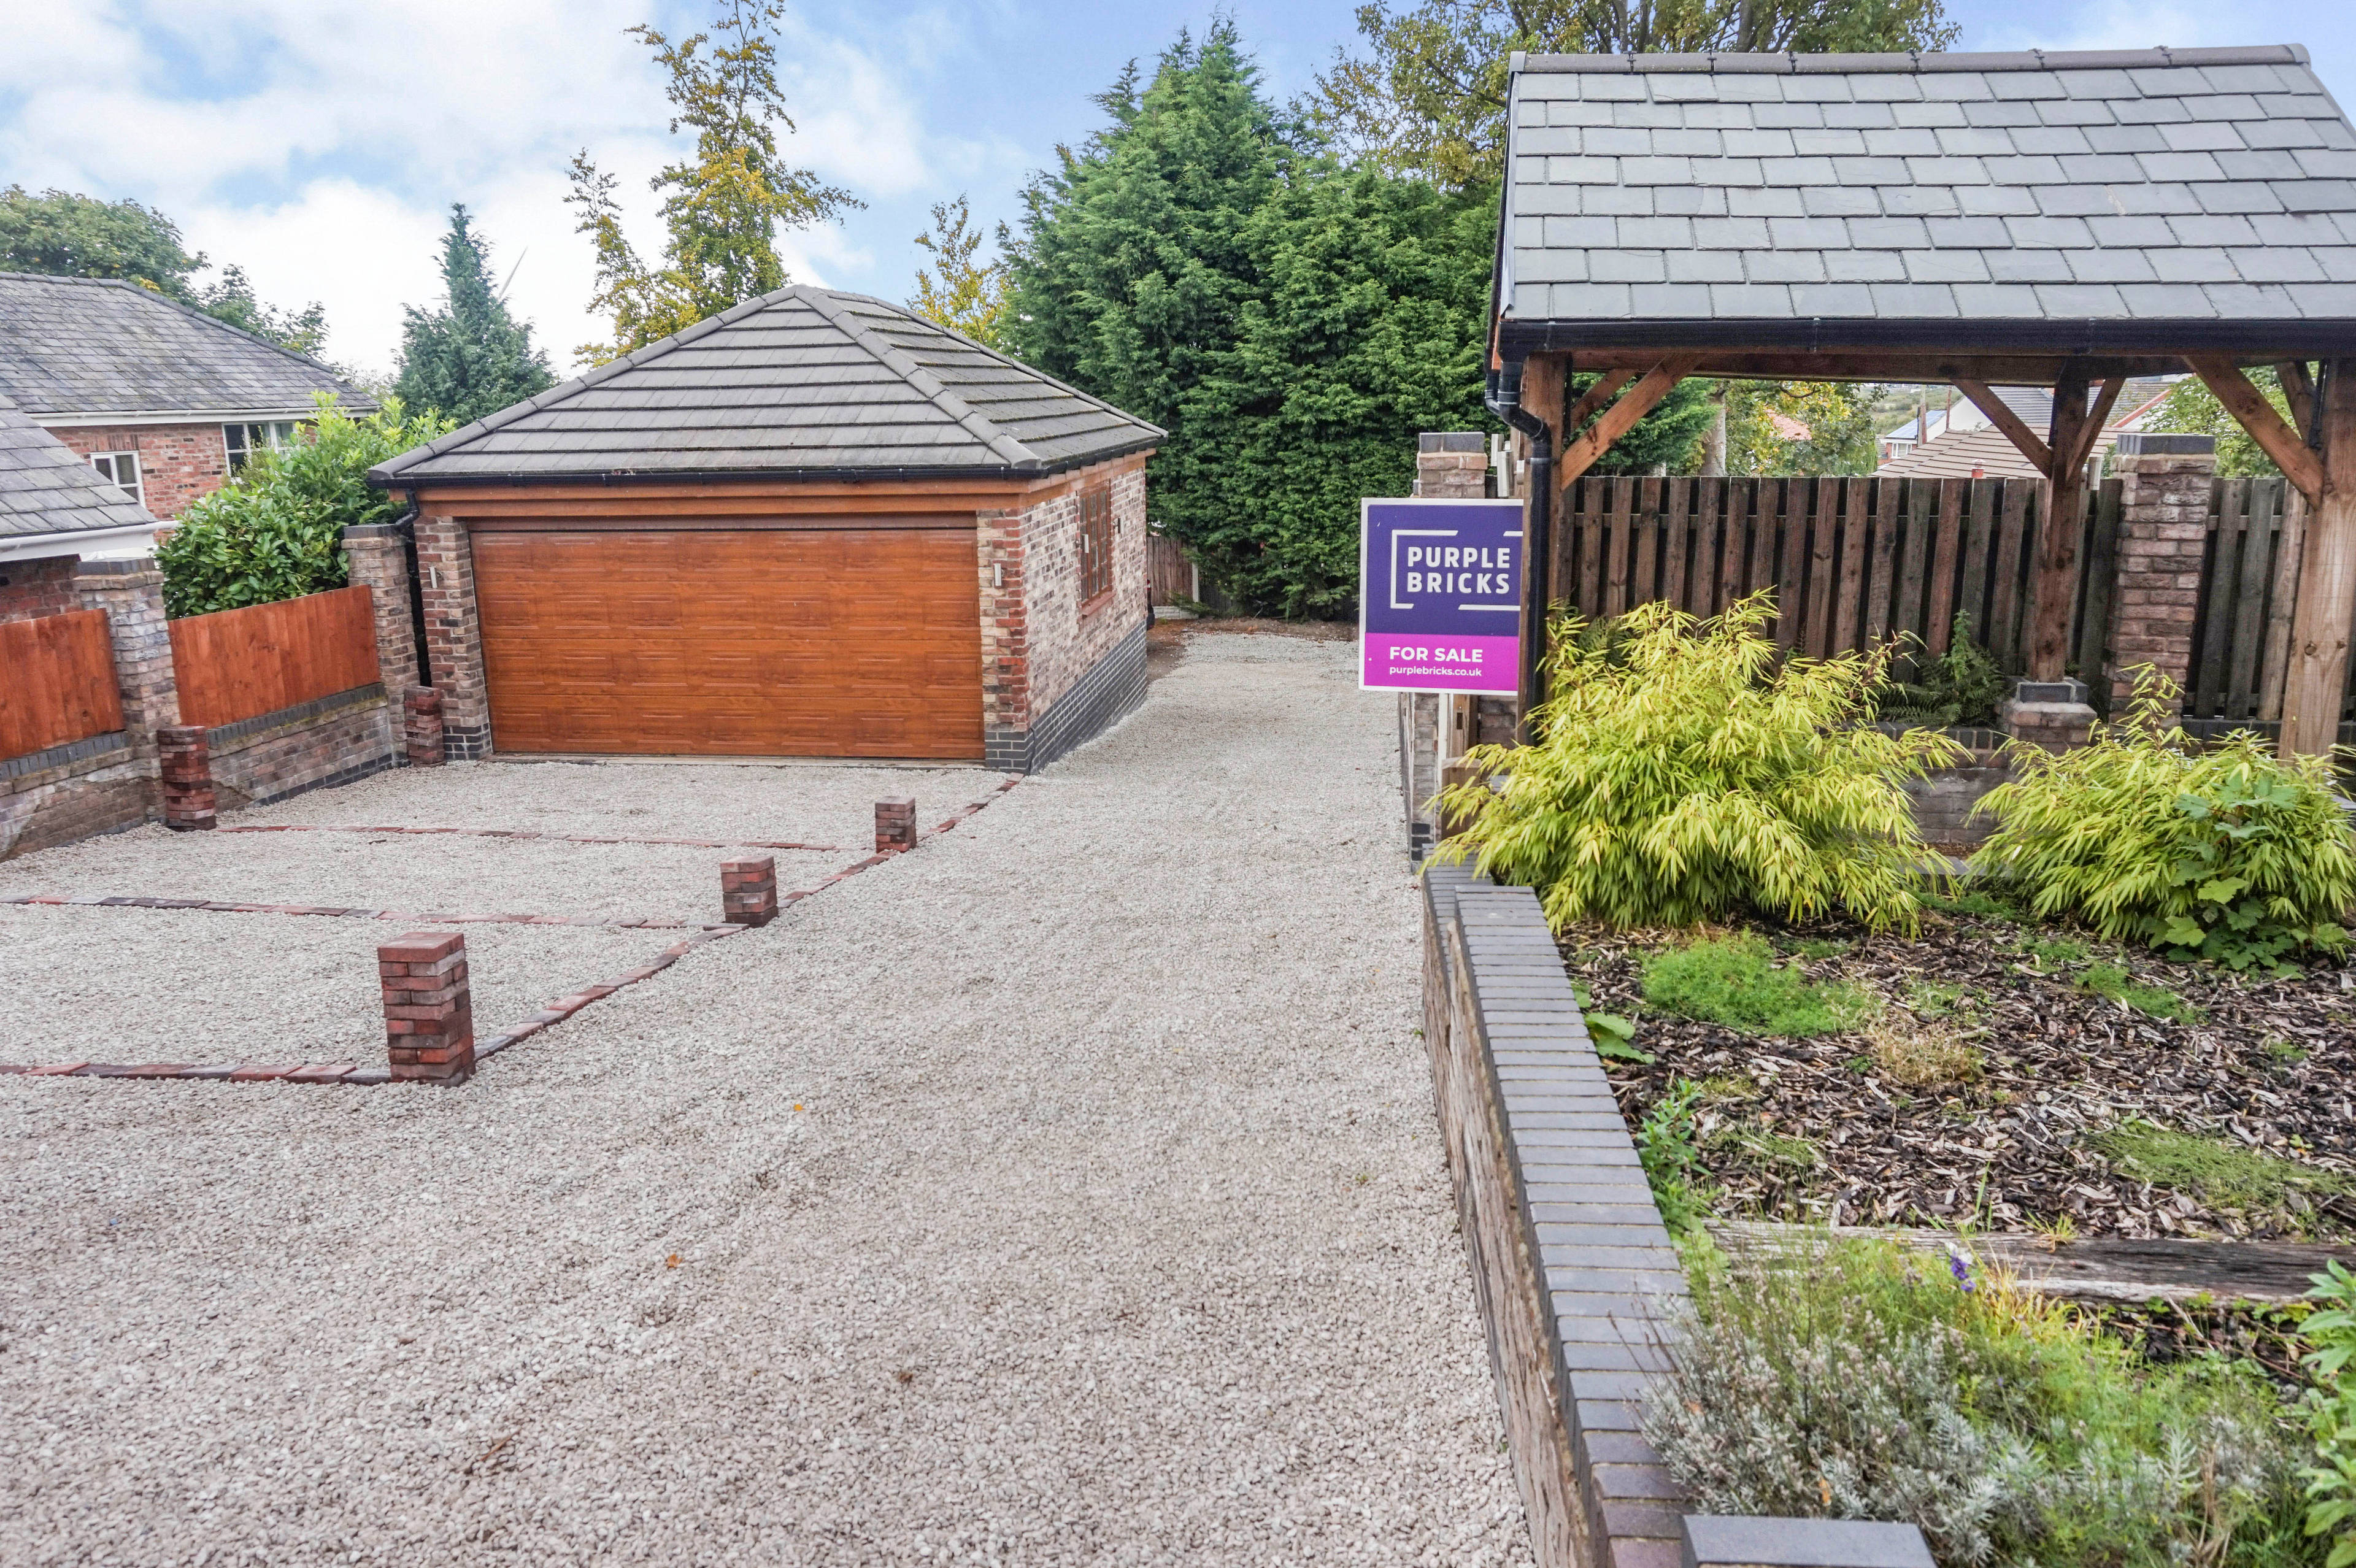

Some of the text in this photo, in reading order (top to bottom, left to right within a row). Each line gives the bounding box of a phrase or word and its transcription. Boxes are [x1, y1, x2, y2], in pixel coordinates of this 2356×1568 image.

[1407, 546, 1511, 569] PURPLE
[1407, 572, 1509, 594] BRICKS
[1390, 646, 1483, 663] FOR SALE
[1389, 666, 1482, 677] purplebricks.co.uk
